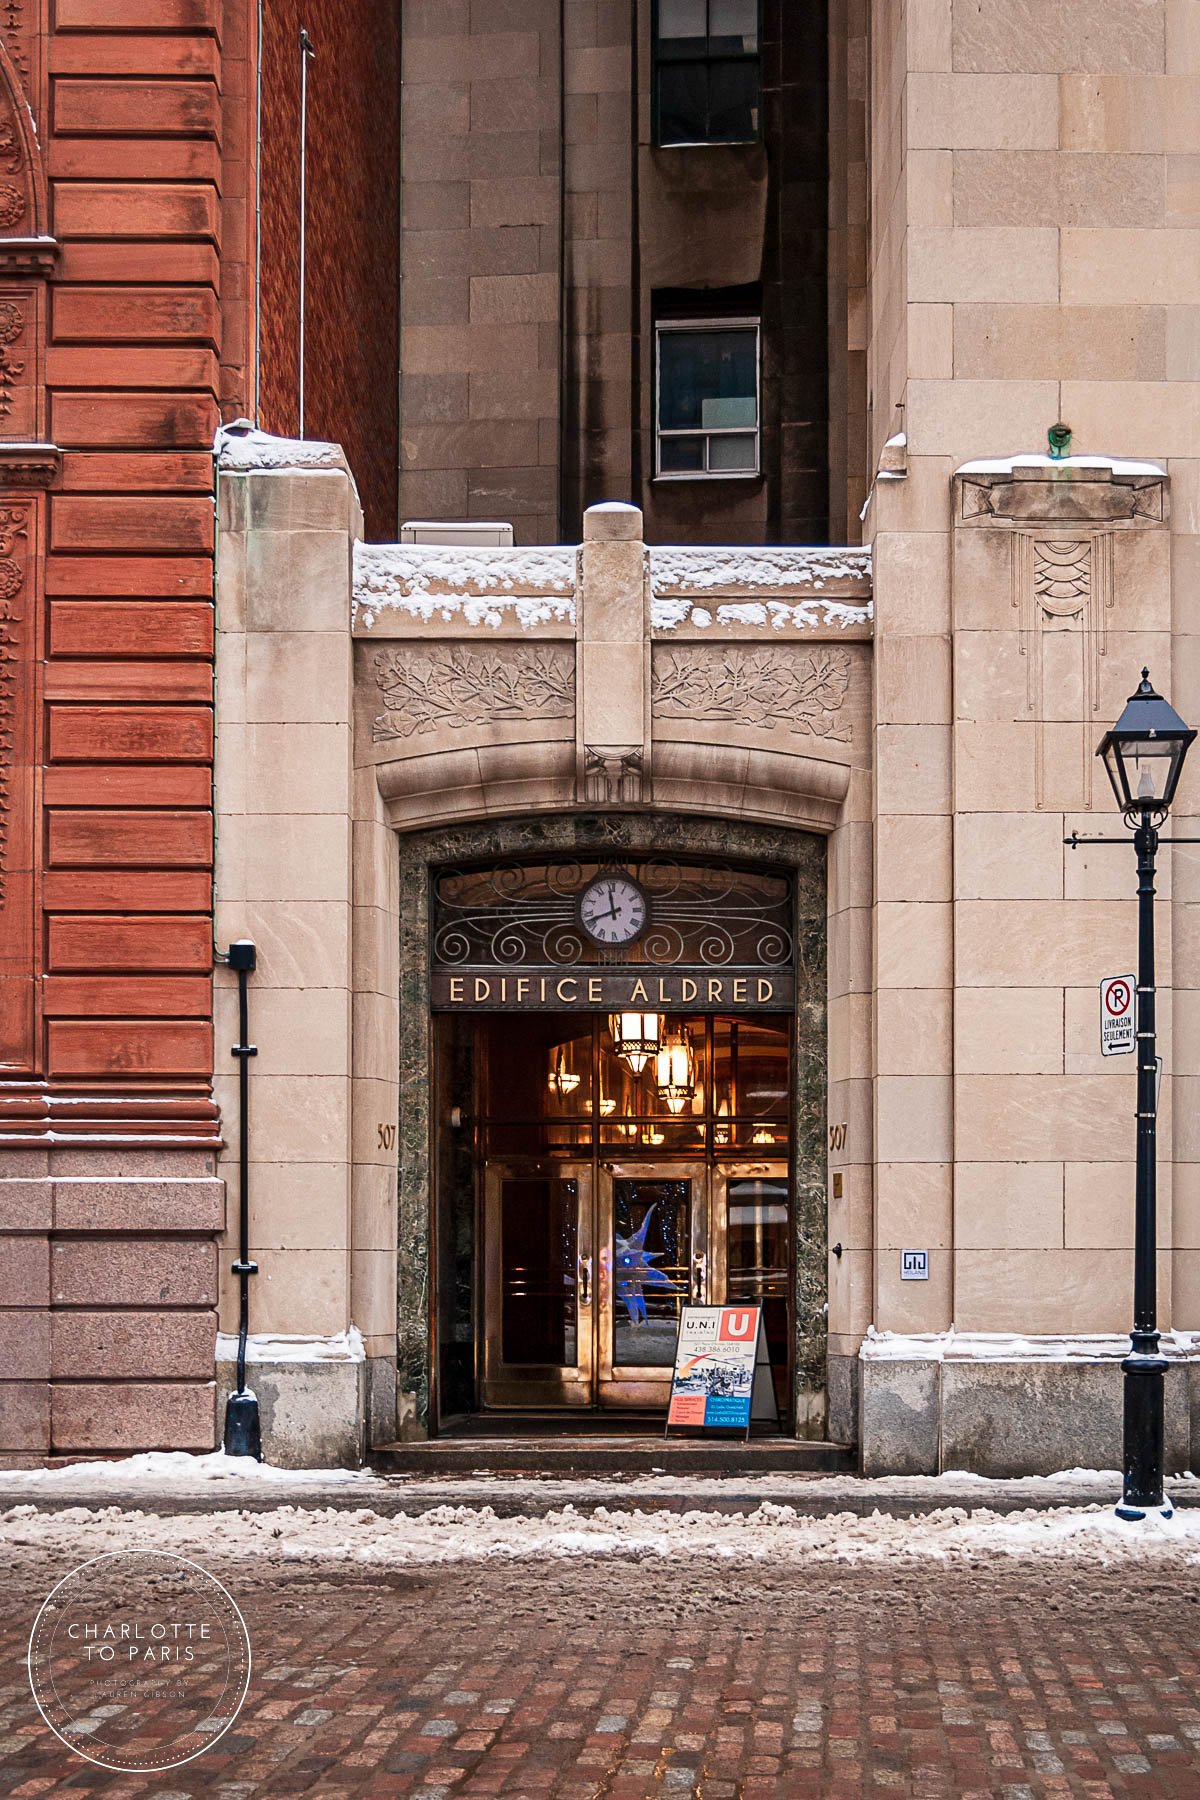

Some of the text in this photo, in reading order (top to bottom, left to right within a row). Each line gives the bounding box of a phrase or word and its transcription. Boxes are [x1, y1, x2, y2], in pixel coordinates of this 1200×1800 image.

[450, 978, 773, 1002] EDIFICE ALDRED
[1104, 1017, 1132, 1029] LIVRAISON
[1103, 1029, 1133, 1042] SEULEMENT
[377, 1123, 396, 1151] 507
[829, 1123, 848, 1151] 507
[686, 1313, 750, 1337] U.N.I U
